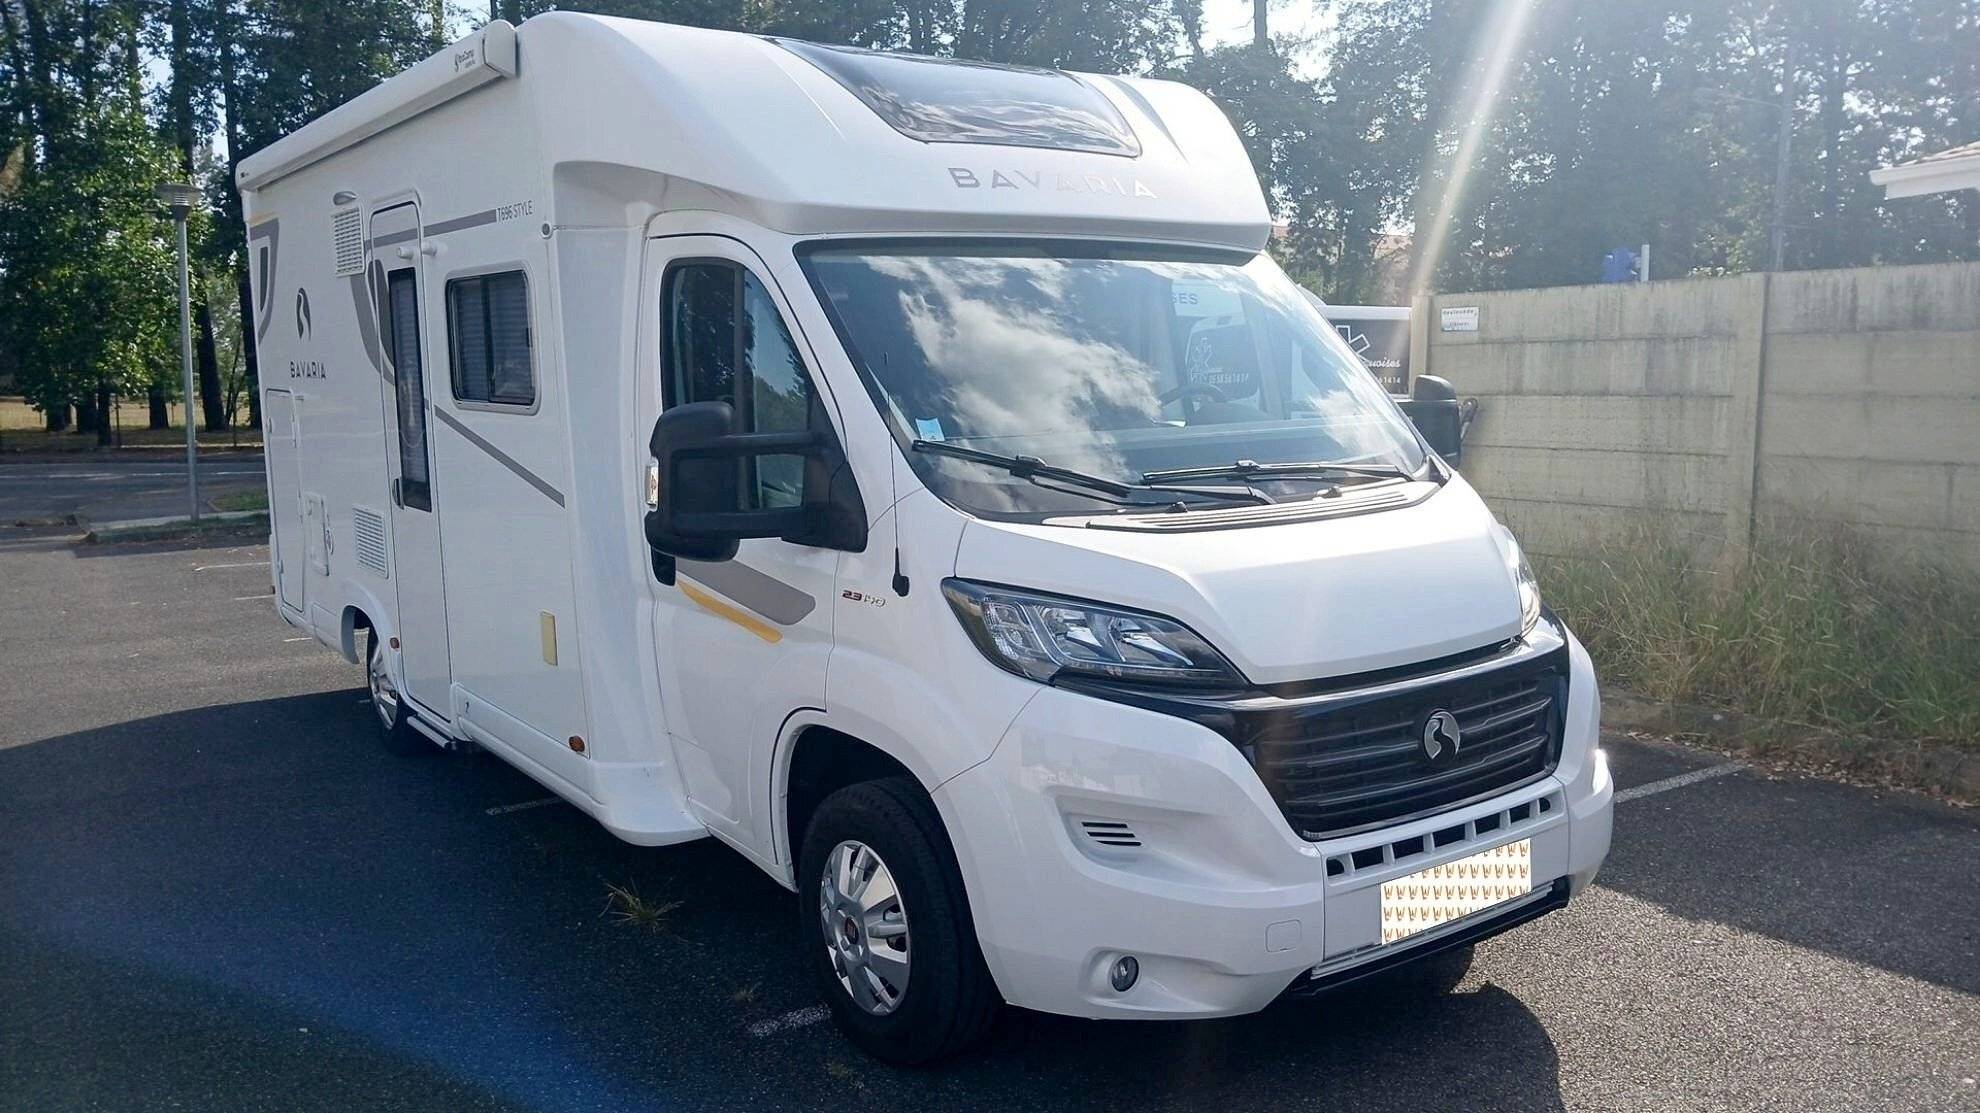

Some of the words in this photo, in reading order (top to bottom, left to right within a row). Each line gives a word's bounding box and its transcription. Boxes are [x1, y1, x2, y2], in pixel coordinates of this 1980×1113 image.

[947, 167, 1158, 199] BAVARIA
[513, 200, 534, 218] STYLE
[290, 361, 327, 379] BAVARIA
